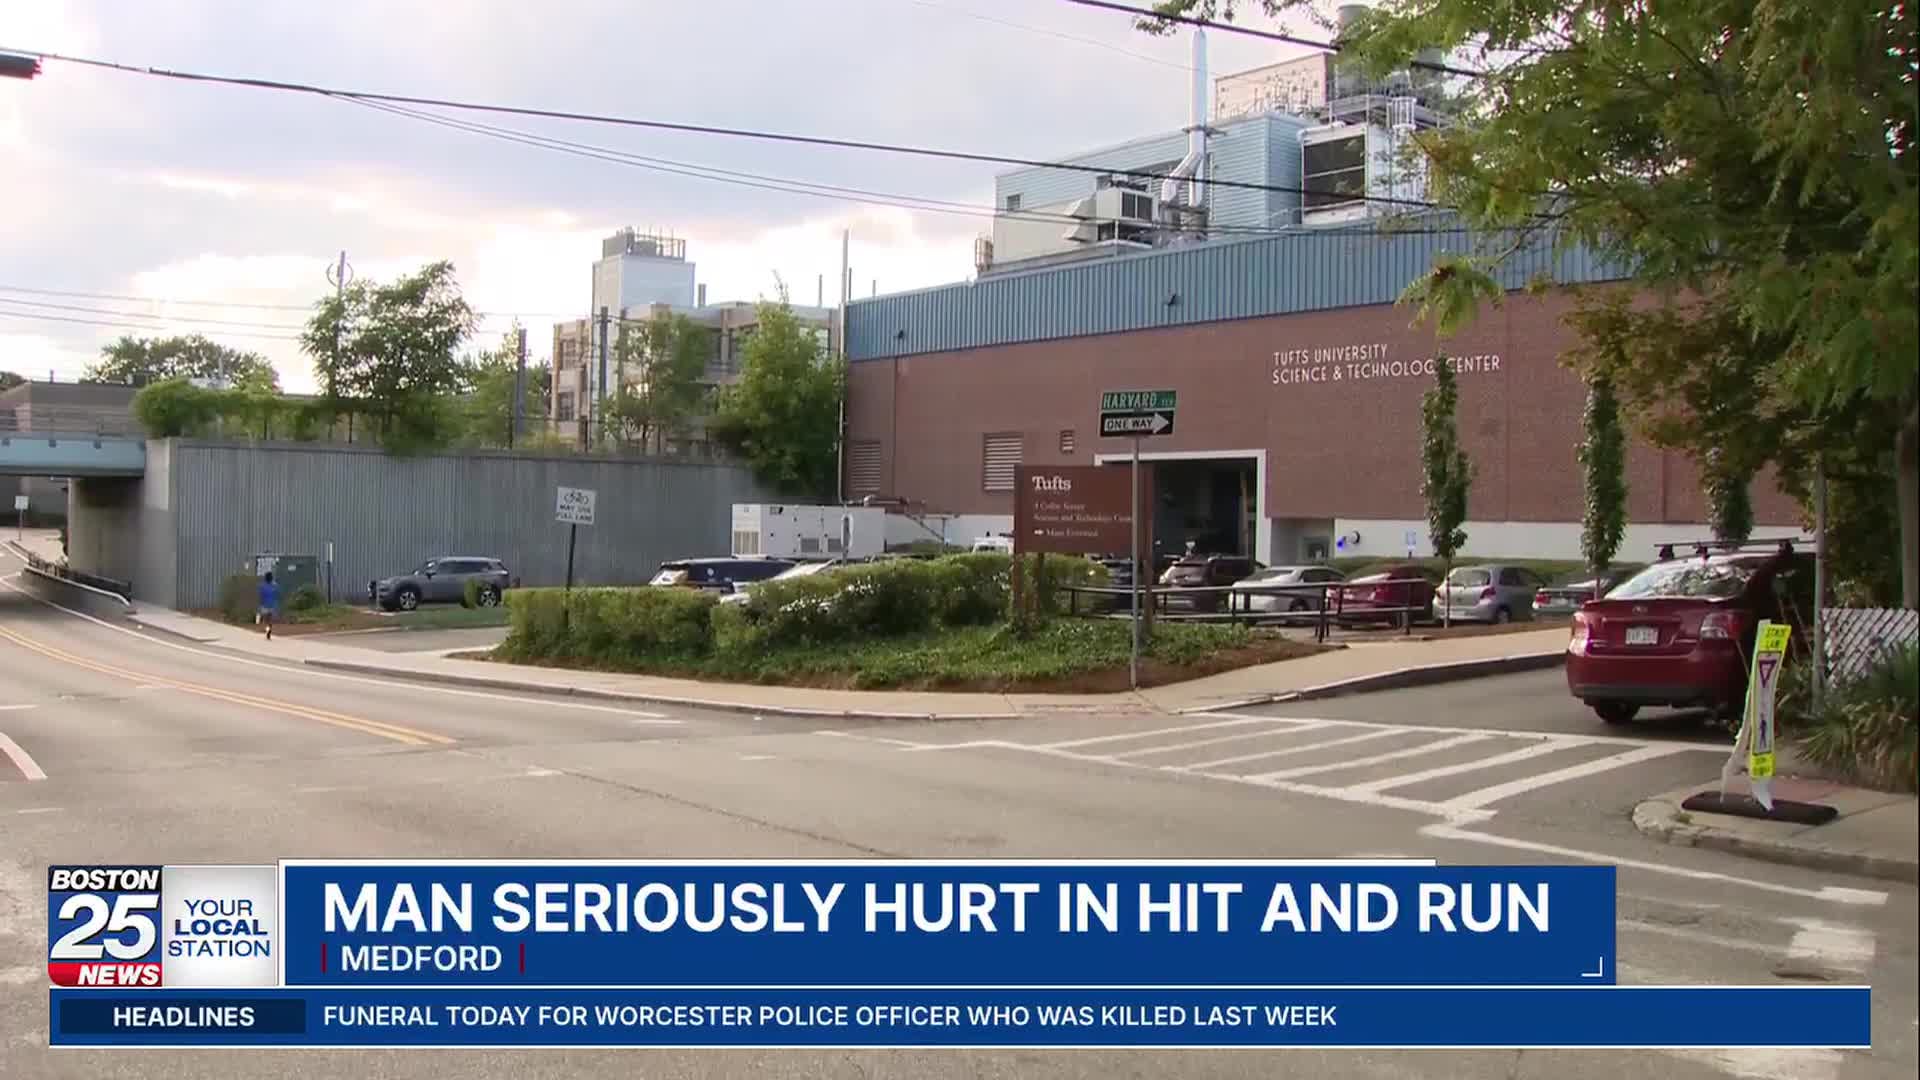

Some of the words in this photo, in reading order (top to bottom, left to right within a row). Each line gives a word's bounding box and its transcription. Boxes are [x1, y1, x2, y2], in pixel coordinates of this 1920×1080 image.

[1273, 350, 1309, 366] TUFTS
[1314, 344, 1388, 363] UNIVERSITY
[1272, 366, 1327, 385] SCIENCE
[1332, 365, 1342, 381] &
[1346, 359, 1437, 379] TECHNOLOG
[1445, 354, 1500, 374] CENTER
[1103, 391, 1157, 409] HARVARD
[1106, 418, 1128, 431] ONE
[1131, 417, 1153, 430] WAY
[1032, 476, 1072, 491] Tufts
